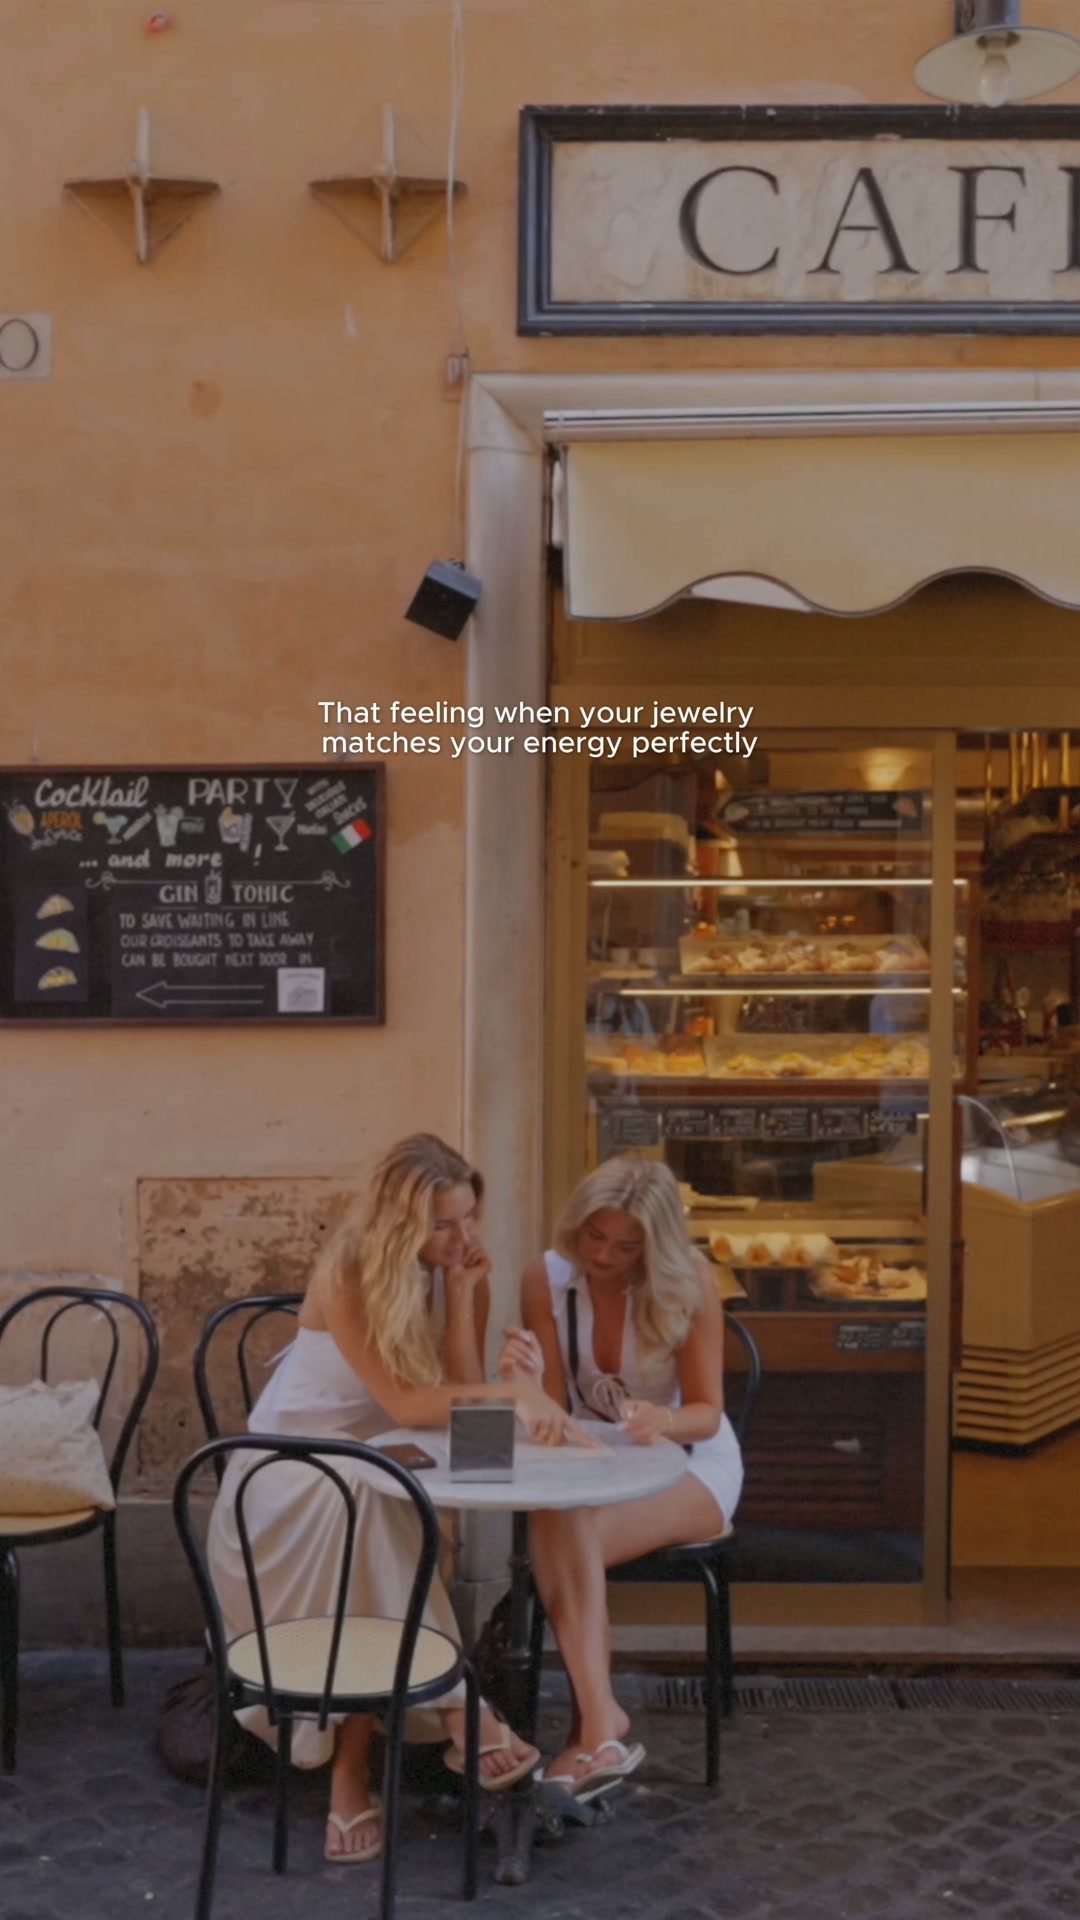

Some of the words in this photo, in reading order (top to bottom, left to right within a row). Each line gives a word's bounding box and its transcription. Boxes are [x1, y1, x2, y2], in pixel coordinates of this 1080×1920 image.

[108, 849, 151, 869] and
[165, 852, 223, 869] more
[159, 884, 199, 904] GIN
[232, 884, 295, 904] TONIC
[119, 913, 136, 929] TO
[142, 913, 174, 929] SAVE
[177, 911, 235, 929] WAITING
[242, 912, 257, 928] IN
[262, 910, 290, 928] LINE
[120, 934, 147, 948] OUR
[228, 933, 244, 948] TO
[246, 932, 275, 948] TAKE
[279, 932, 314, 946] AWAY
[121, 953, 146, 968] CAN
[152, 953, 166, 968] BE
[173, 952, 218, 968] BOUGHT
[225, 952, 254, 967] NEXT
